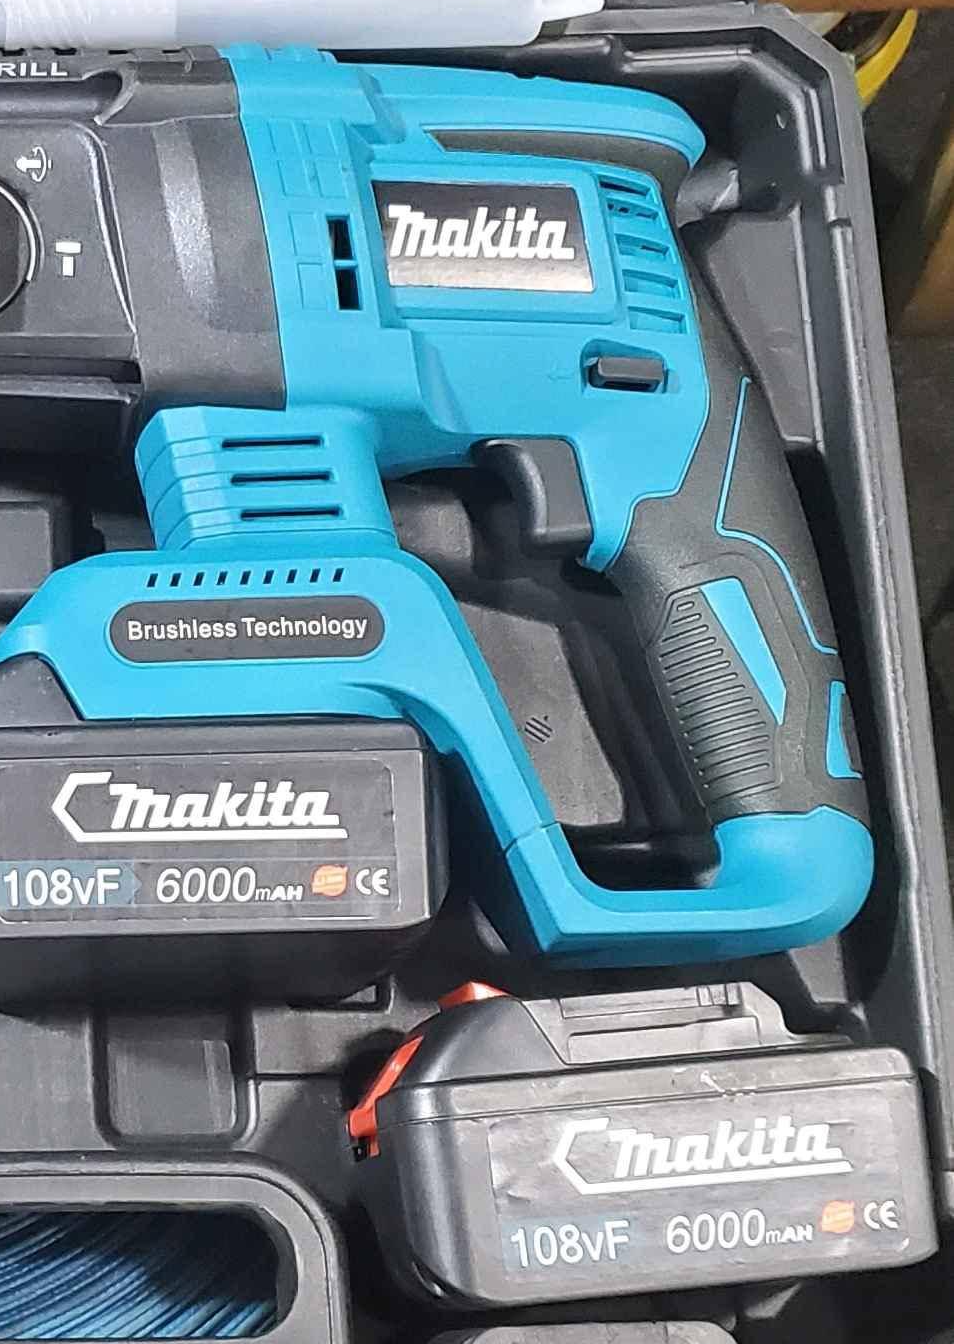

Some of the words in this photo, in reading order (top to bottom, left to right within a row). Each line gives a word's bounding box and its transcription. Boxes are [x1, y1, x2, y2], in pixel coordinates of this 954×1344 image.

[127, 618, 237, 642] Brushless
[241, 615, 368, 641] Technology
[355, 867, 391, 897] CE
[863, 1198, 900, 1231] CE
